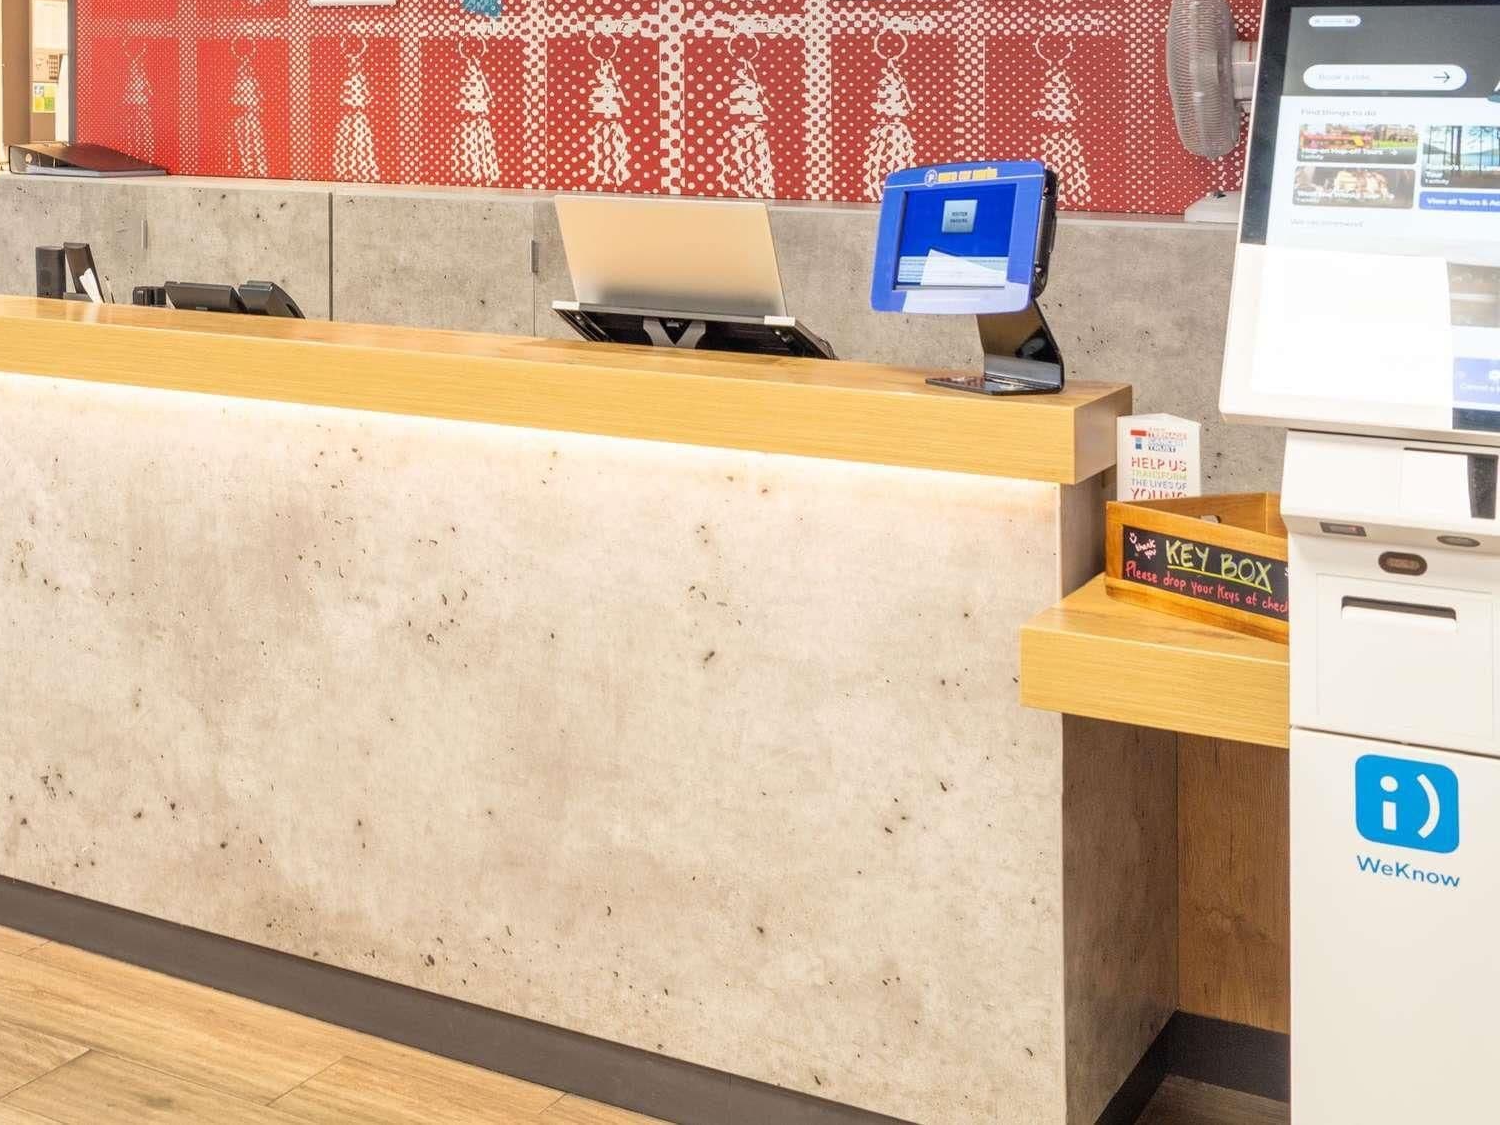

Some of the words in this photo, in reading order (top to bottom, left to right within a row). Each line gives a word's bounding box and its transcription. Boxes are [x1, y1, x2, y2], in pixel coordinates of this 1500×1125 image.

[1131, 456, 1165, 471] HELP
[1168, 459, 1187, 472] US
[1125, 560, 1158, 584] Please
[1163, 571, 1187, 591] drop
[1245, 592, 1257, 607] at
[1165, 539, 1210, 572] KEY
[1220, 553, 1272, 589] BOX
[1356, 855, 1460, 888] WeKnow
